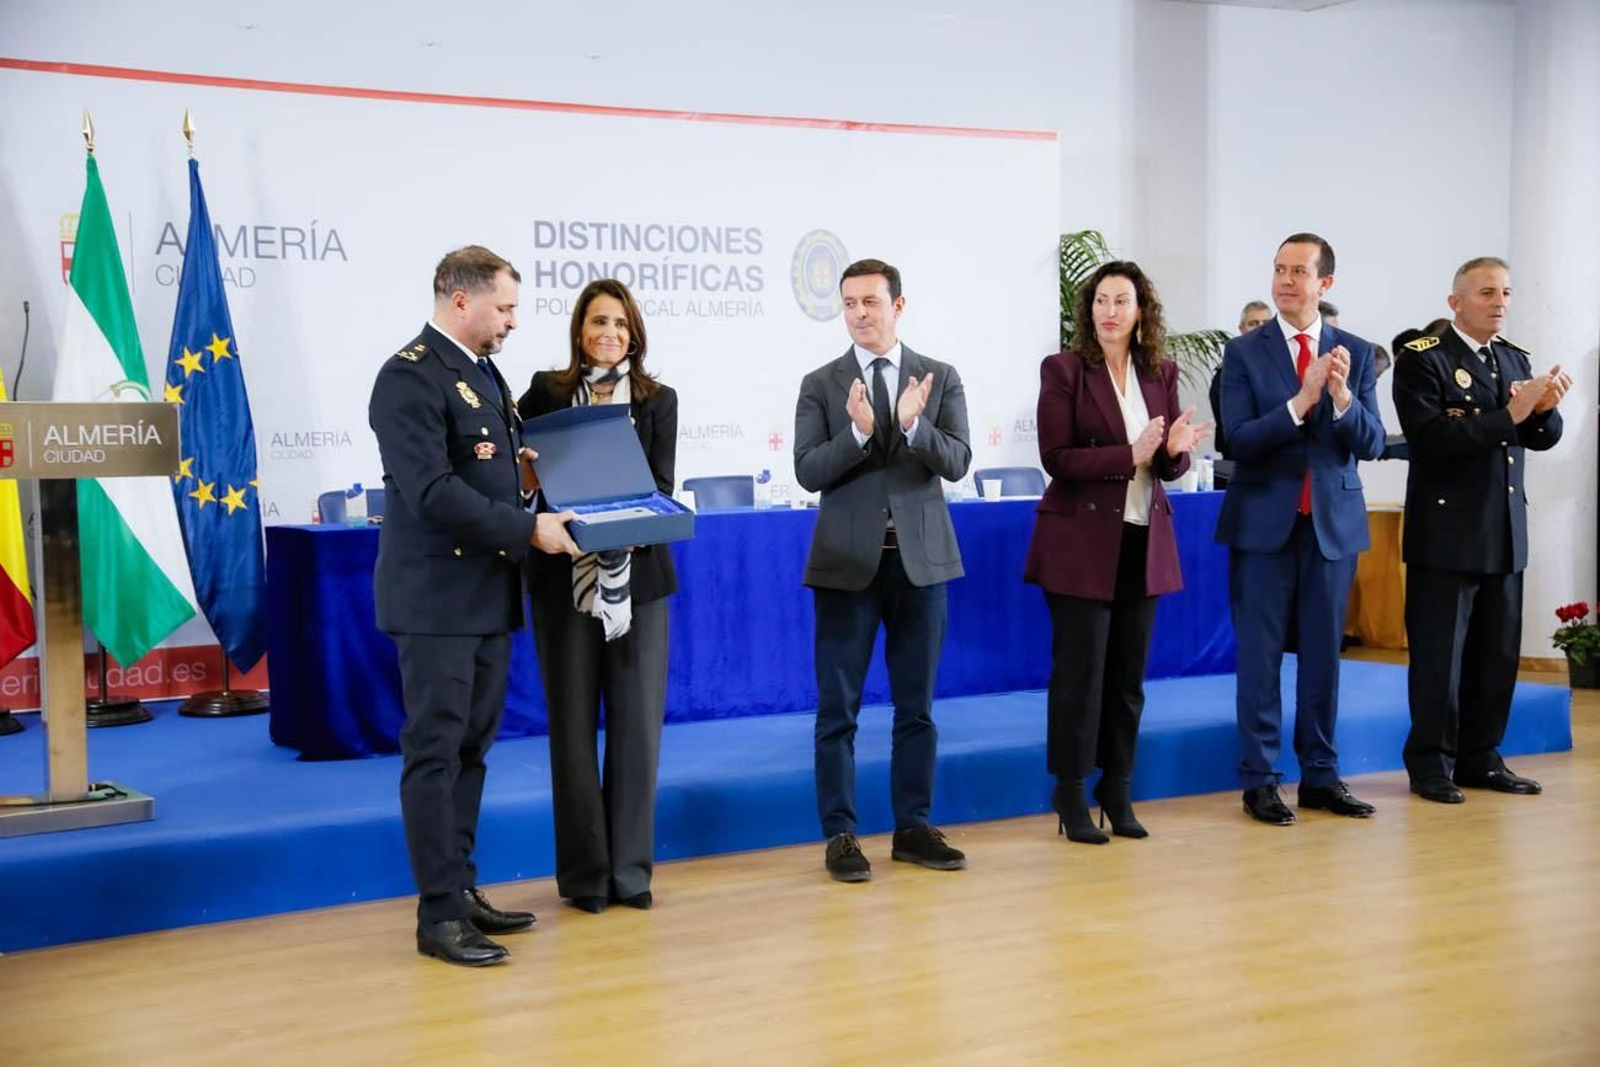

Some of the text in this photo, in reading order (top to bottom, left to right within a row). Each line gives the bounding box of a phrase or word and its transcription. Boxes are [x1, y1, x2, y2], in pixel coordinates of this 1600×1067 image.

[155, 219, 349, 262] AMERÍA
[533, 219, 764, 255] DISTINCIONES
[155, 264, 257, 288] CIAD
[534, 256, 765, 292] HONORÍFICAS
[685, 298, 765, 317] ALMERÍA
[43, 419, 163, 446] ALMERÍA
[43, 450, 106, 464] CIUDAD
